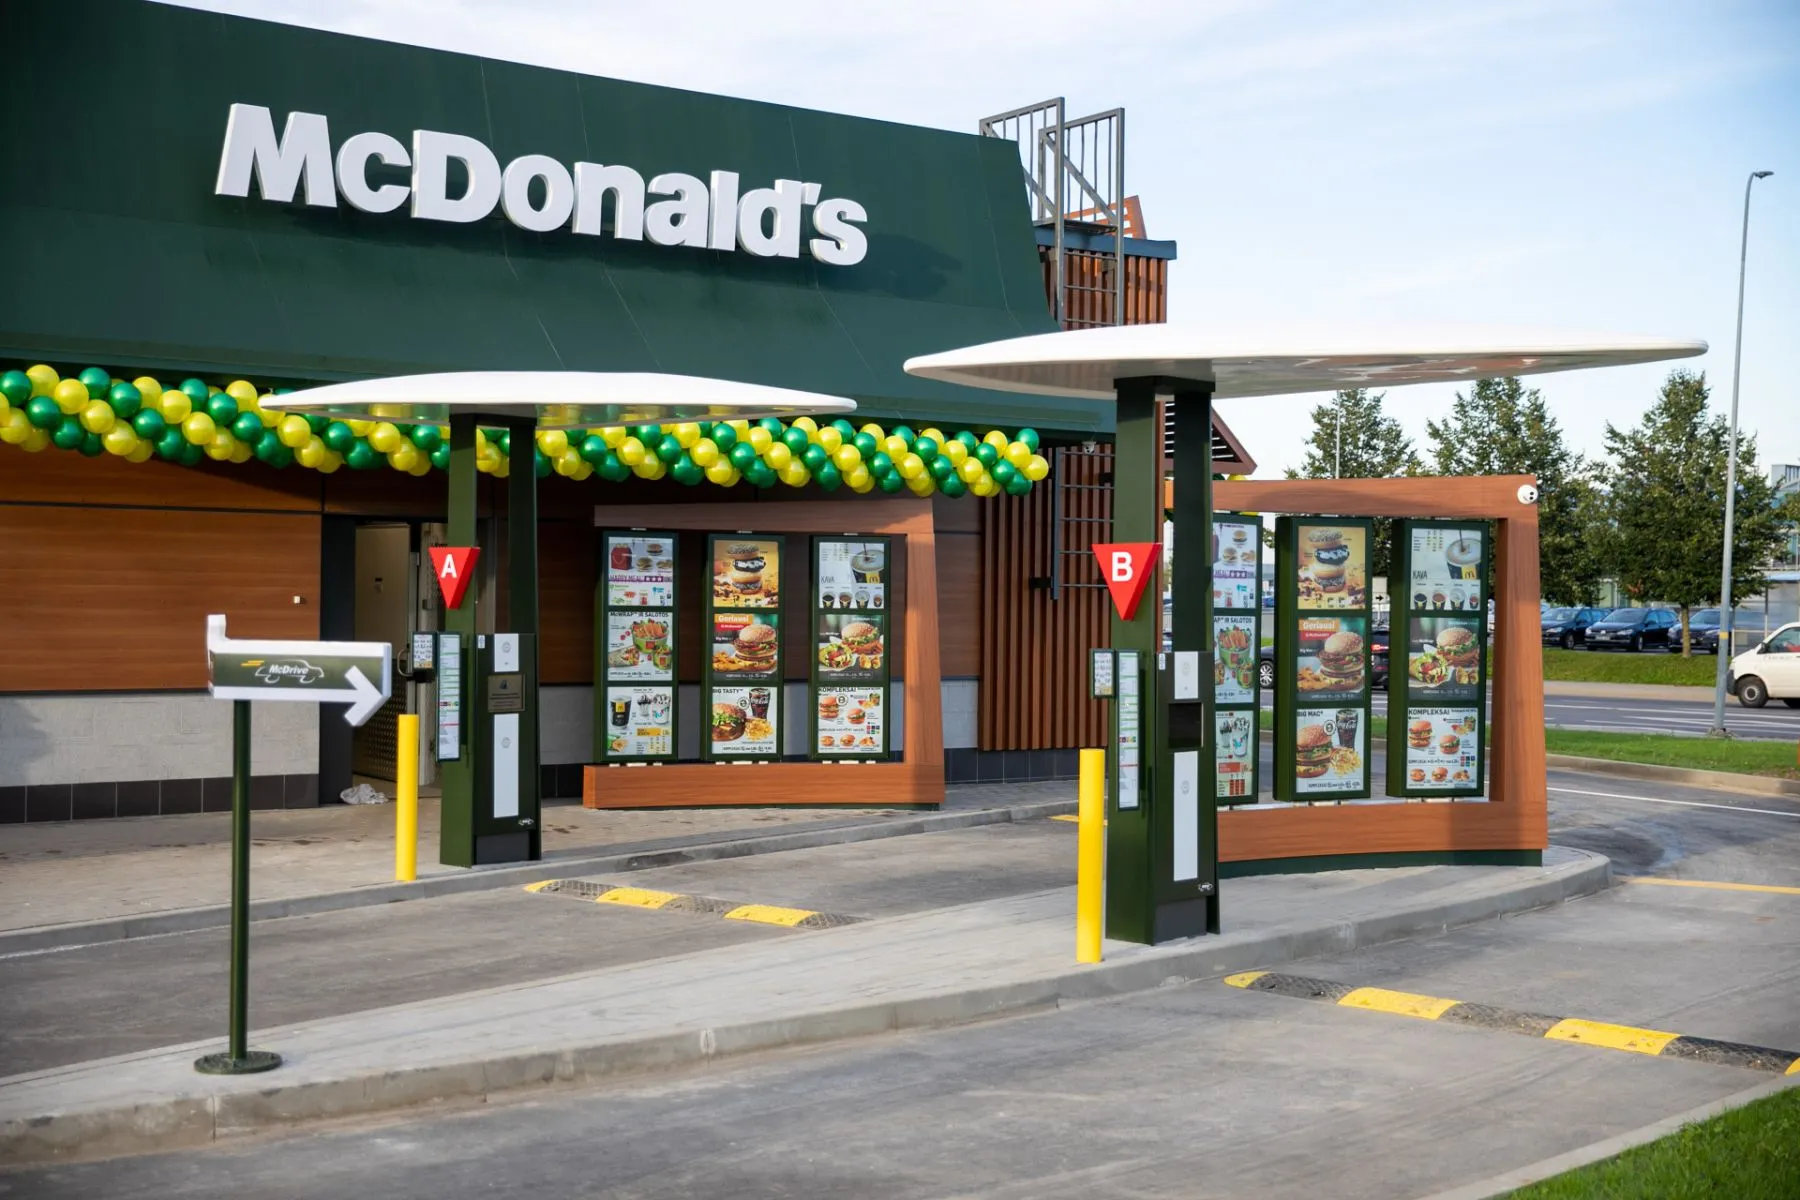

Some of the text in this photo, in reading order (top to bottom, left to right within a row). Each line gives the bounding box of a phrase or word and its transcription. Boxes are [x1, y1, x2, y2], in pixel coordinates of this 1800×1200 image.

[214, 102, 868, 266] McDonald's
[440, 553, 458, 579] A
[1111, 551, 1134, 582] B
[1413, 570, 1427, 580] KAVA
[269, 664, 309, 675] McDrive
